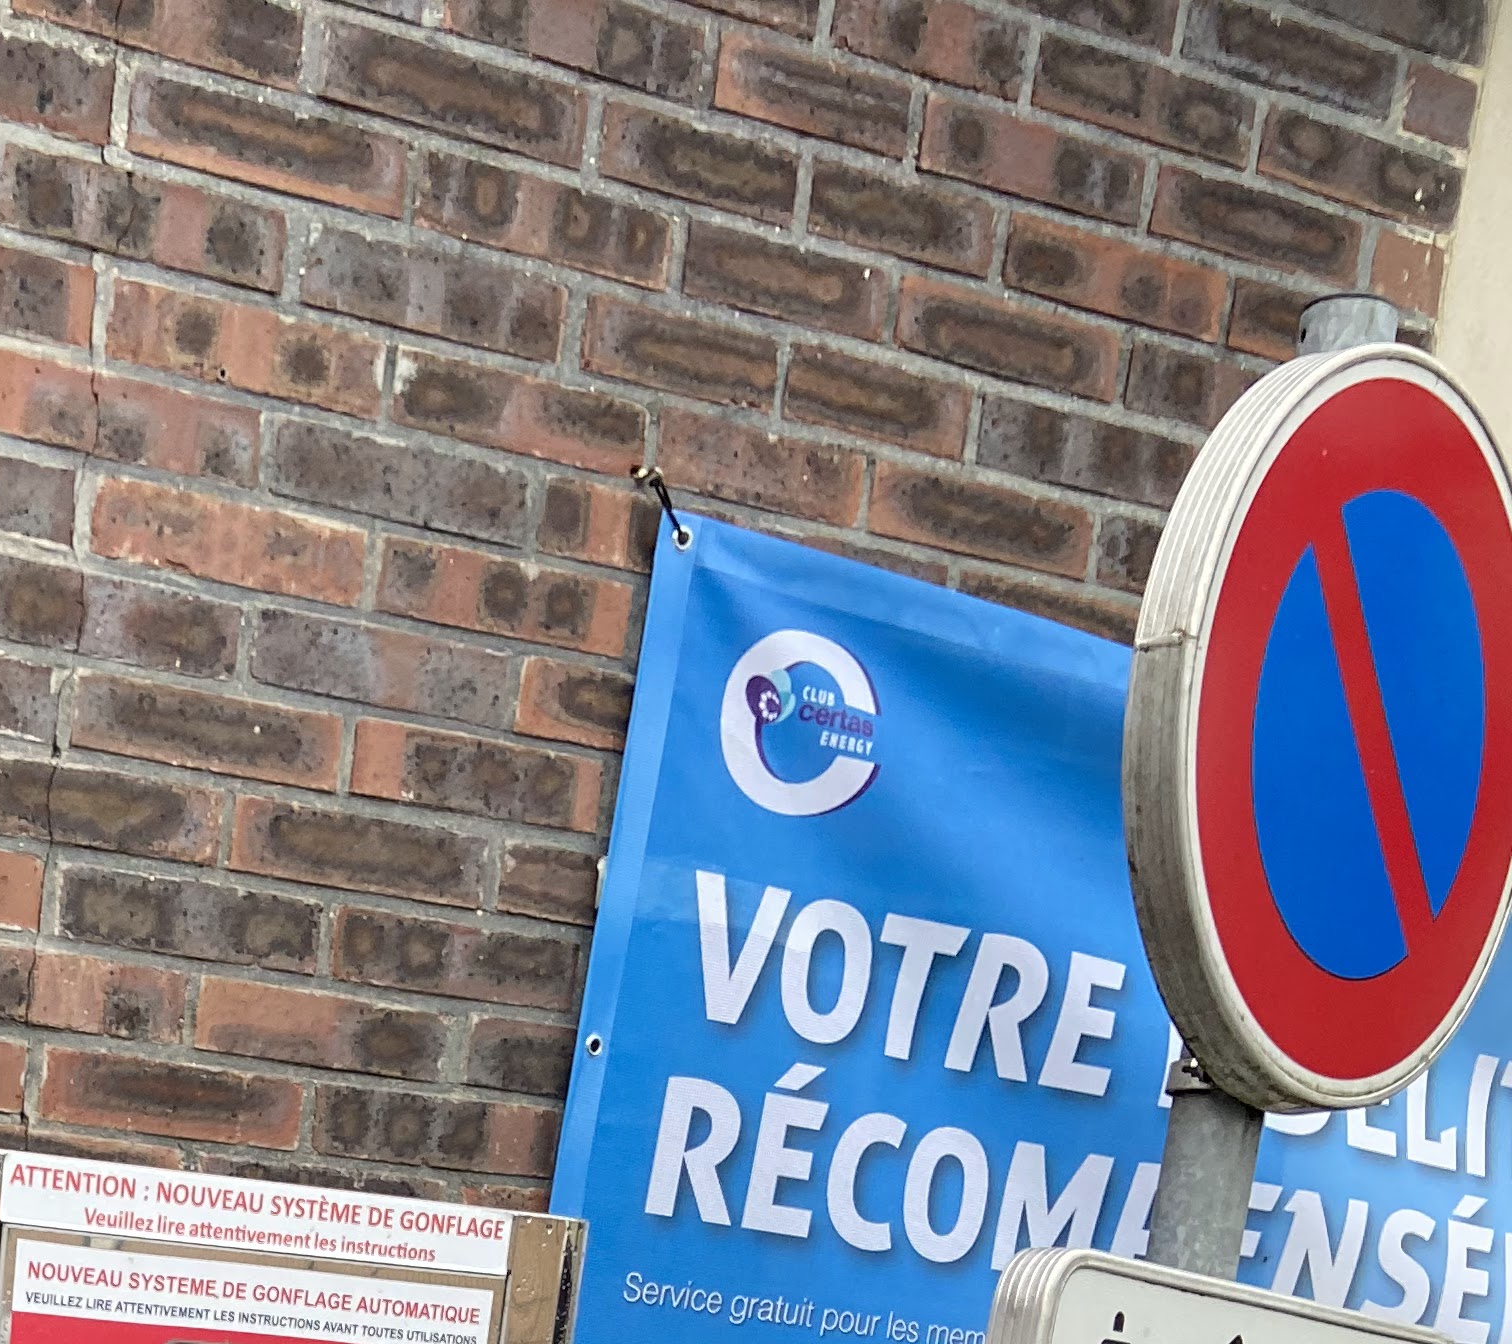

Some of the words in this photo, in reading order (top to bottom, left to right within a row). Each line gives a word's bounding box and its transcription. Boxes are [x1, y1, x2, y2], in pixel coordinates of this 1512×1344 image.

[798, 703, 874, 738] certas
[803, 685, 836, 706] CLUB
[819, 730, 874, 757] ENERGY
[695, 869, 1127, 1097] VOTRE
[10, 1163, 137, 1199] ATTENTION
[156, 1181, 264, 1213] NOUVEAU
[270, 1195, 361, 1225] SYSTÈME
[368, 1205, 395, 1229] DE
[400, 1210, 505, 1240] GONFLAGE
[85, 1207, 154, 1232] Veuillez
[157, 1214, 186, 1236] lire
[189, 1221, 312, 1249] attentivement
[314, 1232, 337, 1251] les
[341, 1236, 436, 1262] instructions
[25, 1291, 83, 1309] VEUILLEZ
[86, 1298, 112, 1312] LIRE
[116, 1301, 210, 1320] ATTENTIVEMENT
[213, 1310, 235, 1323] LES
[238, 1312, 320, 1331] INSTRUCTIONS
[323, 1321, 358, 1336] AVANT
[361, 1325, 403, 1340] TOUTES
[27, 1260, 122, 1288] NOUVEAU
[128, 1272, 221, 1297] SYSTEME
[223, 1281, 247, 1300] DE
[252, 1284, 353, 1310] GONFLAGE
[356, 1296, 481, 1325] AUTOMATIQUE
[622, 1271, 722, 1315] Service
[730, 1293, 815, 1328] gratuit
[819, 1306, 881, 1337] pour
[886, 1311, 919, 1343] les
